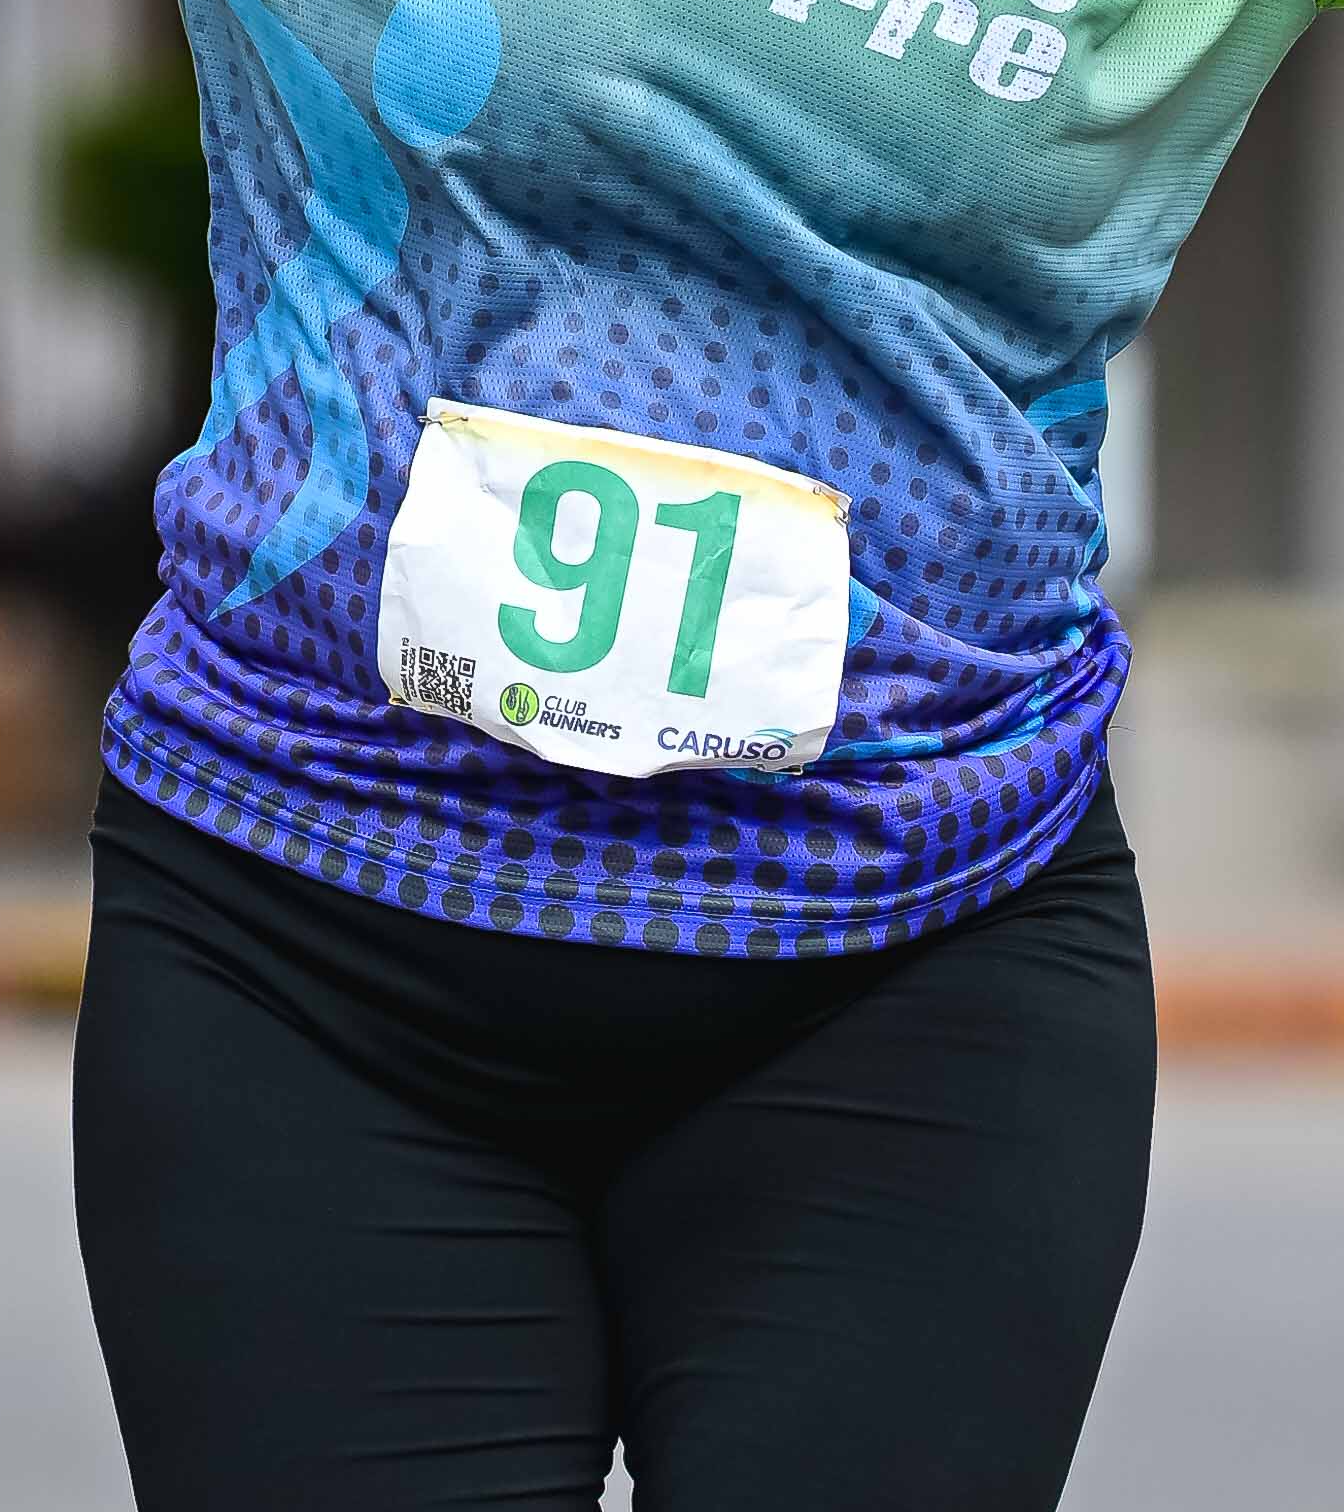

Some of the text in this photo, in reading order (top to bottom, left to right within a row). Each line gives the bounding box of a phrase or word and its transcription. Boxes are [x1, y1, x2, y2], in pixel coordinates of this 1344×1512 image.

[497, 459, 742, 699] 91
[543, 695, 587, 716] CLUB
[538, 710, 623, 740] RUNNER'S
[657, 726, 787, 761] CARUSO
